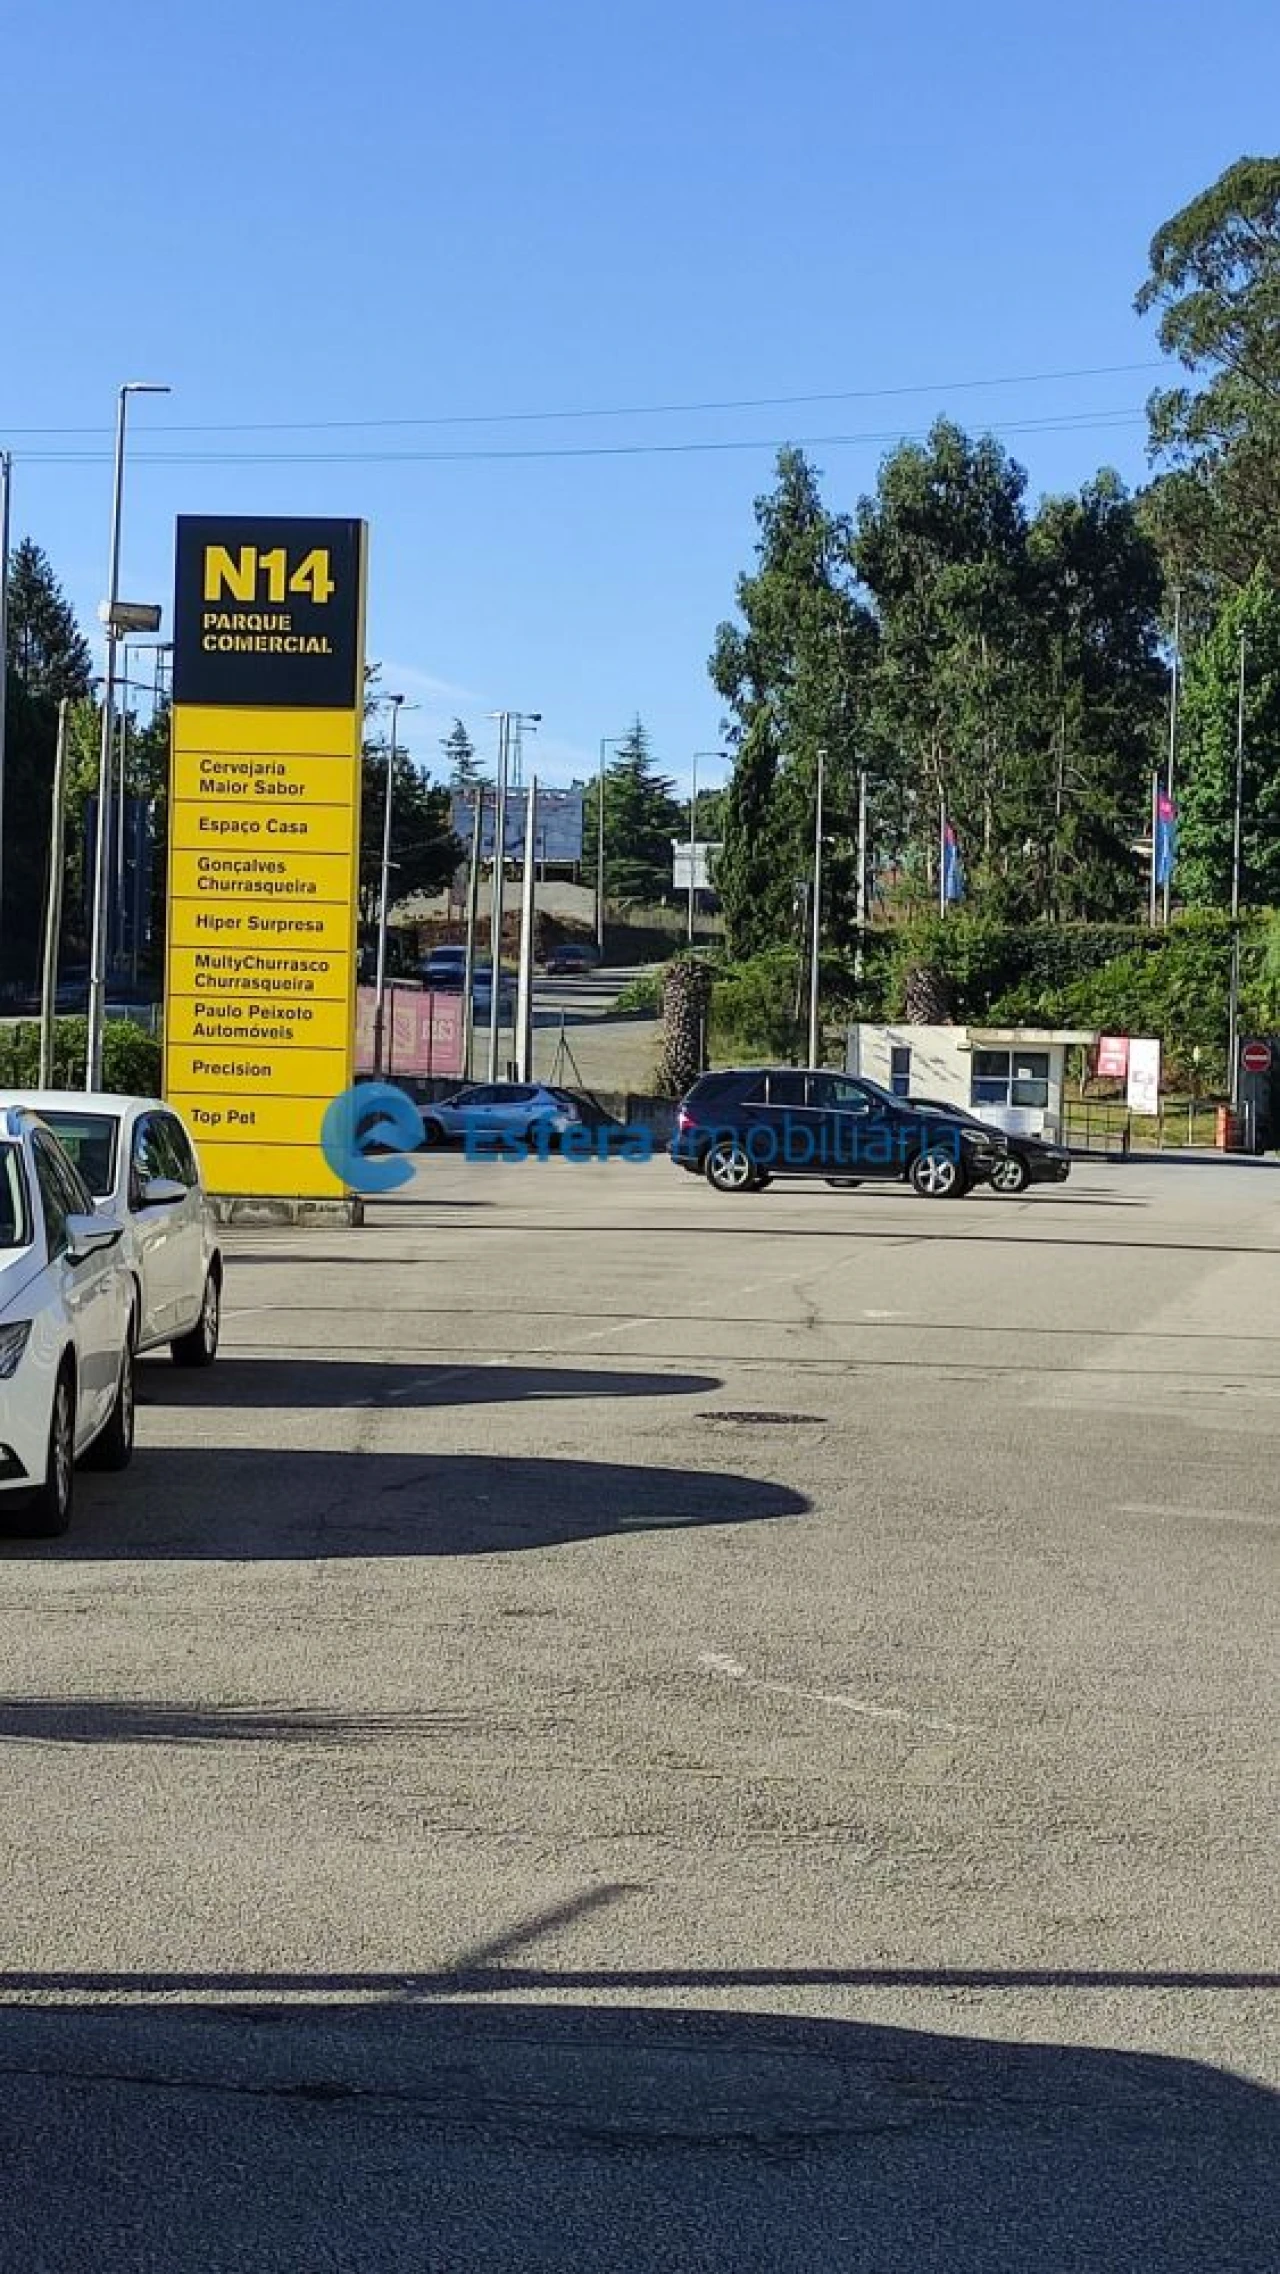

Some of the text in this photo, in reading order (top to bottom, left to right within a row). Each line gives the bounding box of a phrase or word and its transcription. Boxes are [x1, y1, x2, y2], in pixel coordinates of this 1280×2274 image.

[205, 546, 334, 603] N14
[203, 613, 291, 631] PARQUE
[203, 634, 332, 654] COMERCIAL
[199, 759, 286, 778] Cervejaria
[199, 779, 305, 796] Maior Sabor
[199, 816, 308, 836] Espaço Casa
[197, 857, 287, 875] Gonçalves
[197, 876, 317, 895] Churrasqueira
[195, 913, 324, 933] Hiper Surpresa
[195, 954, 330, 974] MultyChurrasco
[194, 973, 315, 993] Churrasqueira
[194, 1002, 314, 1021] Paulo Peixoto
[192, 1022, 295, 1040] Automóveis
[192, 1060, 272, 1077] Precision
[191, 1109, 256, 1126] Top Pet
